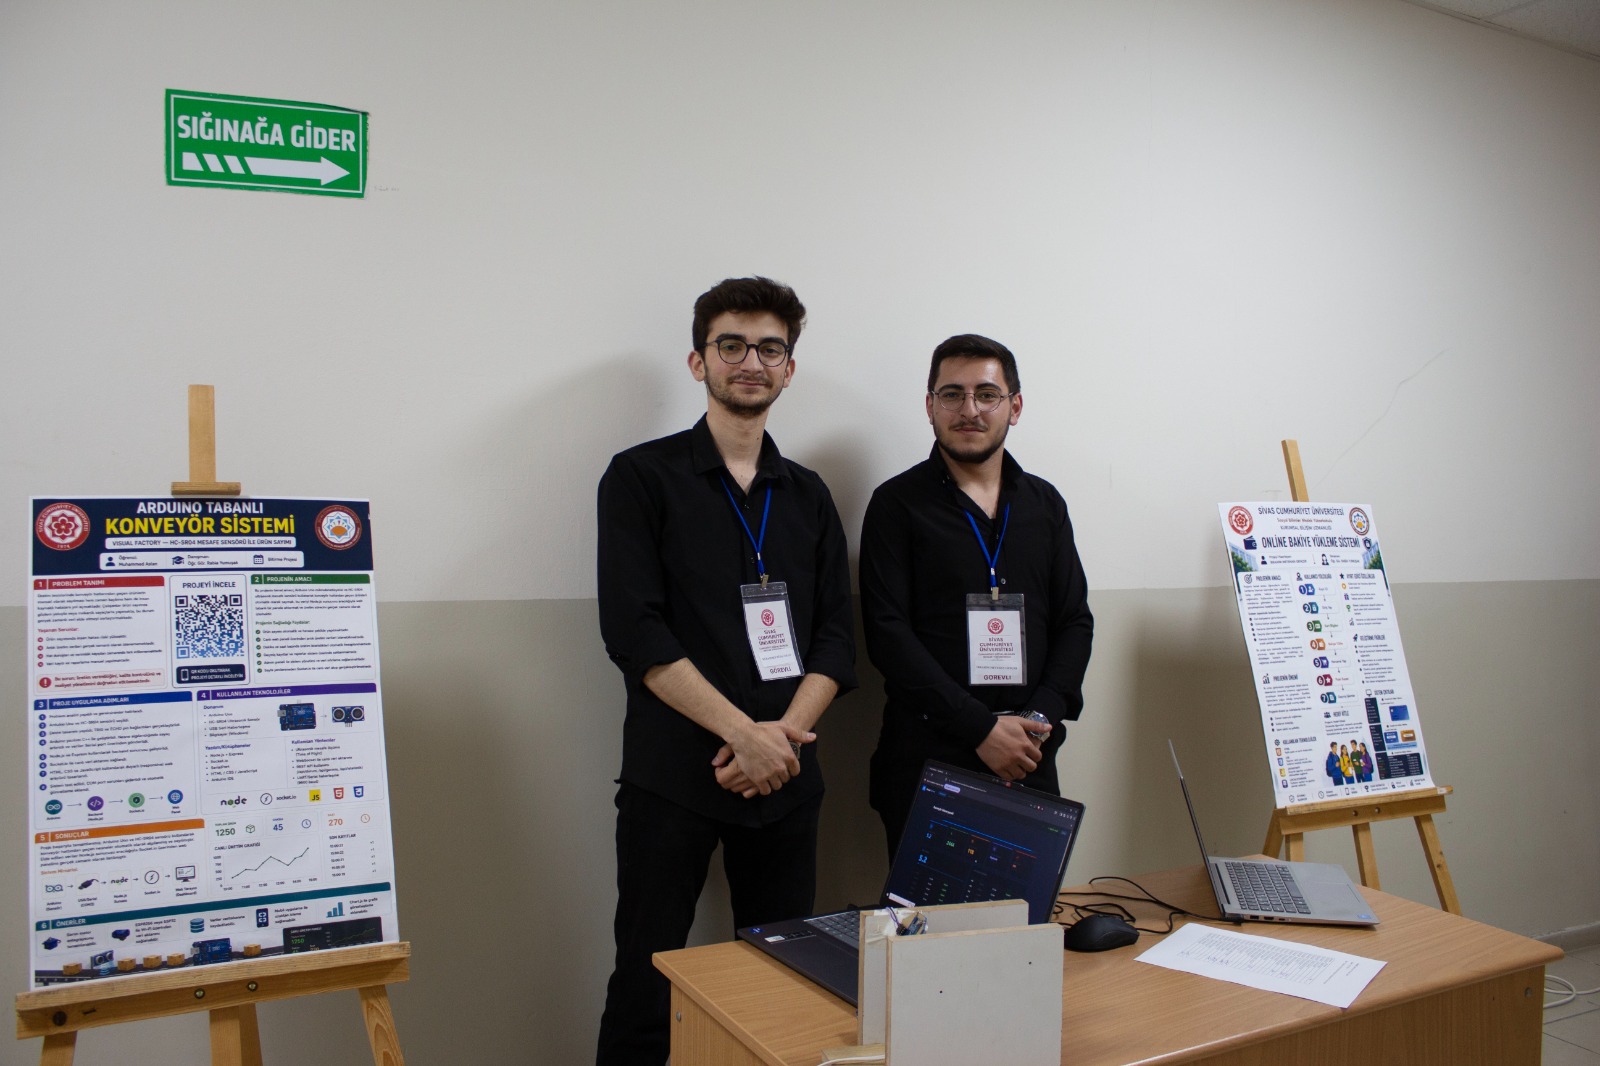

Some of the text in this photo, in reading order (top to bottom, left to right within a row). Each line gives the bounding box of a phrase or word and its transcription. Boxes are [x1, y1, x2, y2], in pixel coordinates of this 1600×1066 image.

[177, 111, 356, 152] SIĞINAĞA GİDER
[137, 501, 263, 514] ARDUINO TABANLI
[1258, 507, 1276, 515] SİVAS
[1276, 506, 1311, 515] CUMHURİYET
[105, 513, 295, 535] KONVEYÖR SİSTEMİ
[1261, 534, 1361, 549] ONLİNE BAKİYE YÜKLEME SİSTEMİ
[212, 580, 236, 588] İNCELE
[272, 823, 284, 831] 45
[328, 818, 344, 827] 270
[215, 828, 236, 836] 1250
